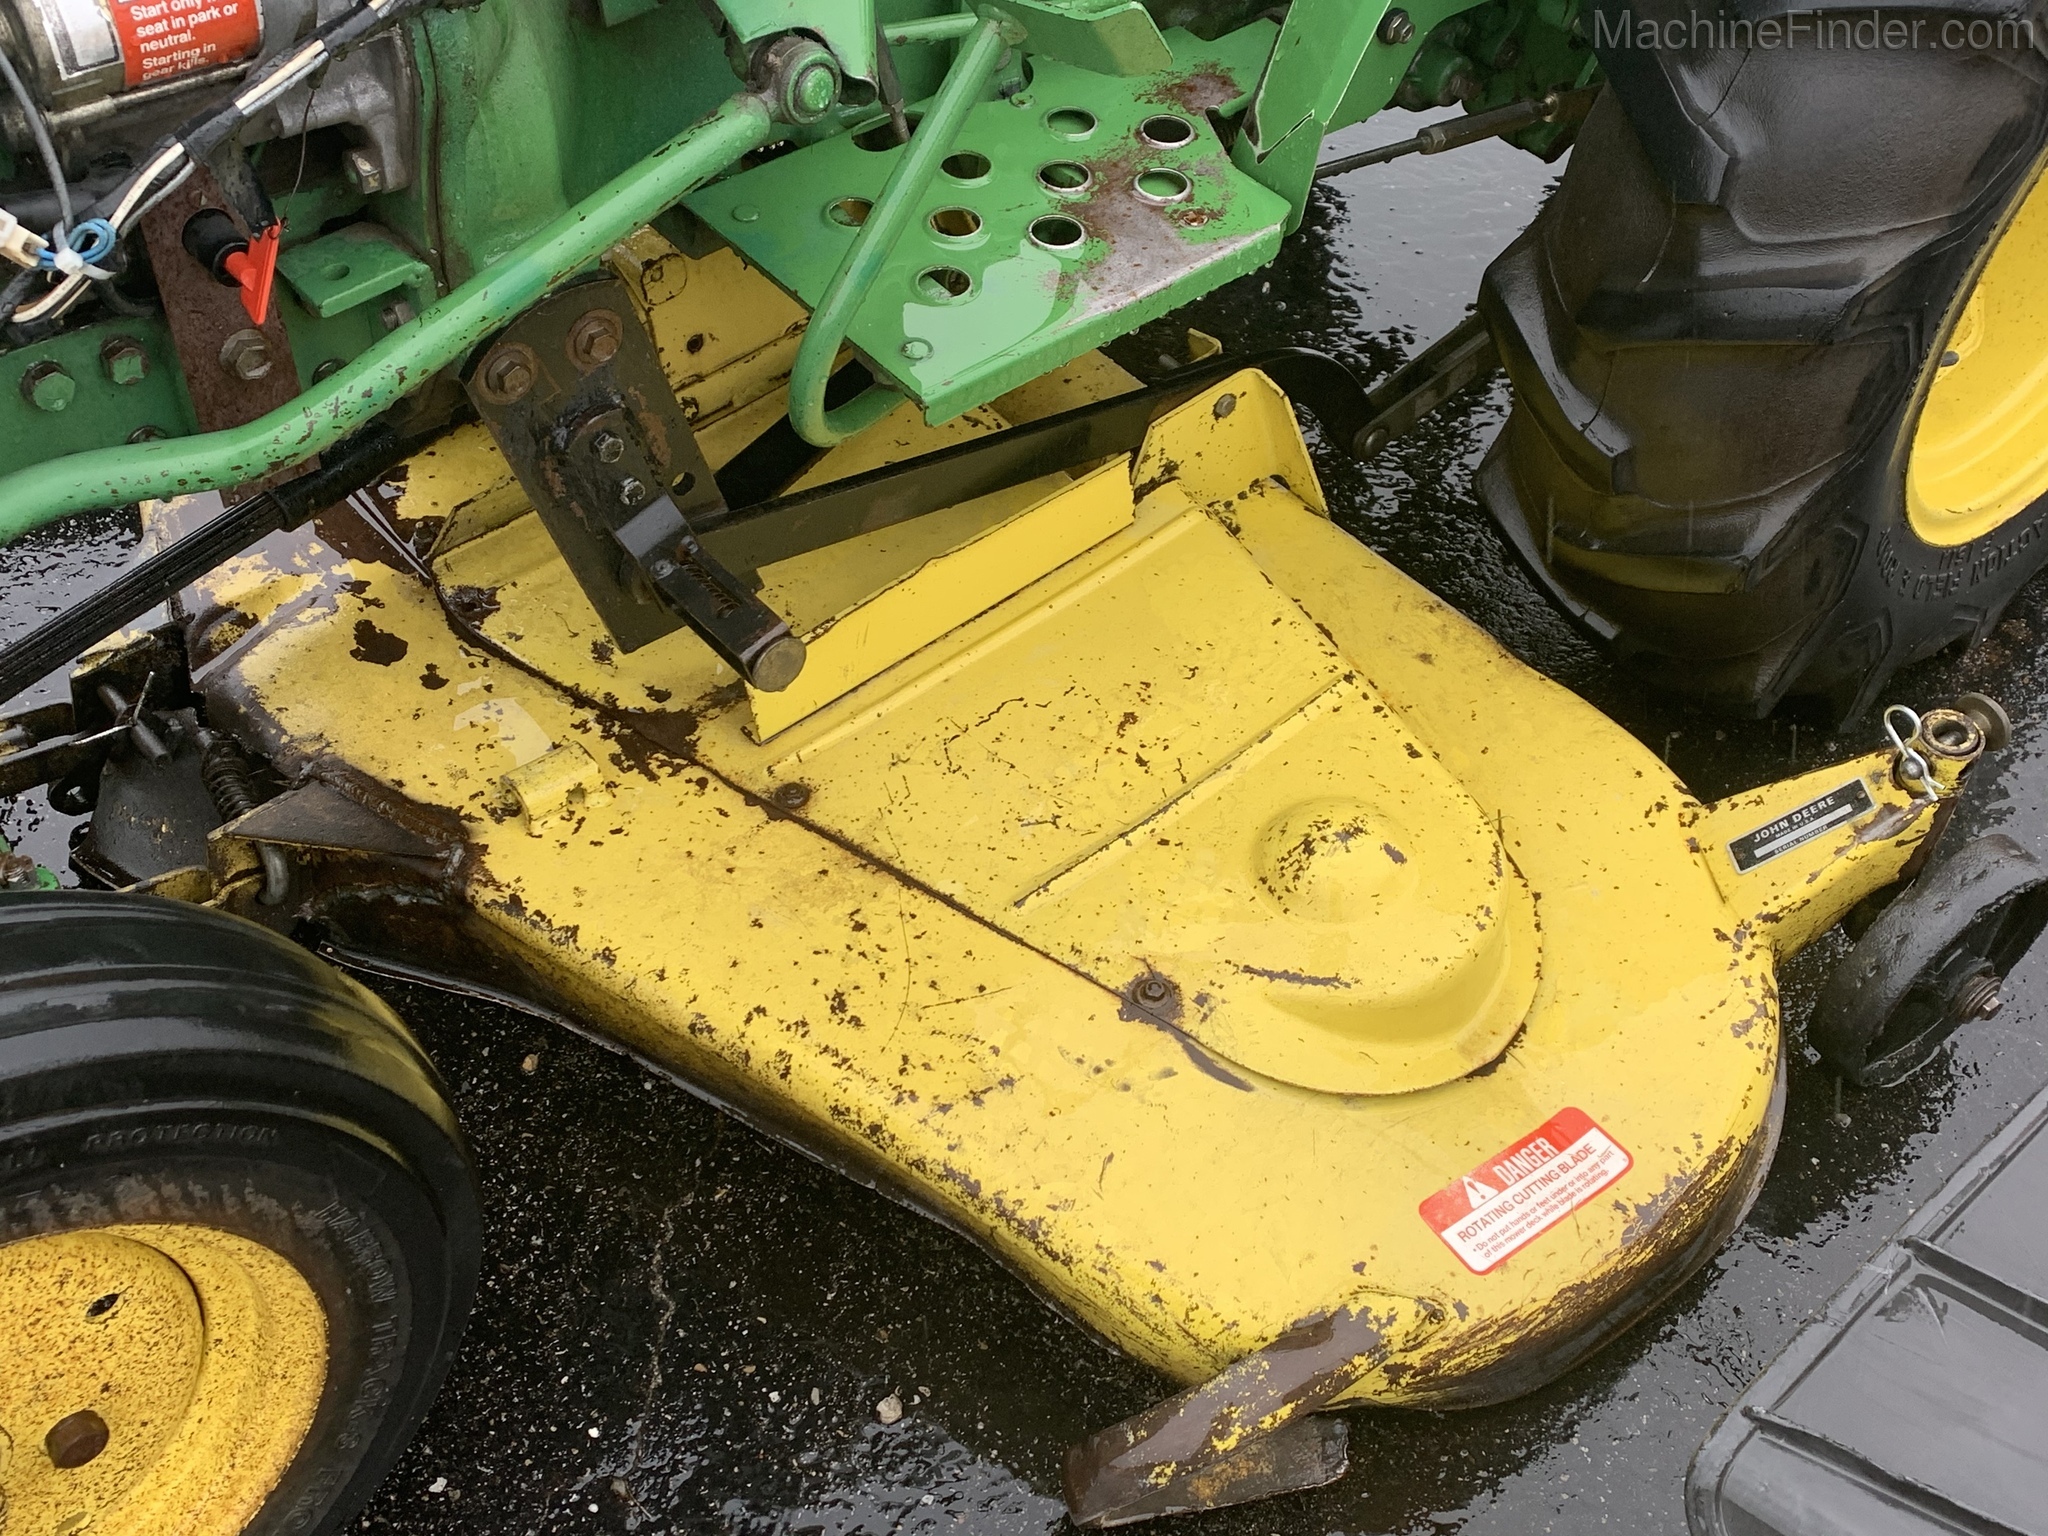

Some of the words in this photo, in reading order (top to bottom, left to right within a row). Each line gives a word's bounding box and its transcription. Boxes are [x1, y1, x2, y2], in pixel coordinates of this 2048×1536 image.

[130, 1, 169, 21] Start
[136, 18, 170, 38] seat
[170, 15, 186, 29] in
[187, 6, 221, 28] park
[223, 3, 238, 16] or
[140, 29, 196, 53] neutral.
[142, 48, 200, 69] Starting
[203, 43, 216, 53] in
[142, 64, 175, 80] gear
[1753, 819, 1789, 843] JOHN
[1791, 796, 1836, 823] DEERE
[1775, 827, 1791, 838] MADE
[1773, 840, 1797, 854] SERIAL
[1798, 824, 1828, 841] NUMBER
[84, 1122, 280, 1152] PROTECTION
[1492, 1137, 1559, 1187] DANGER
[1457, 1200, 1516, 1243] ROTATING
[1512, 1169, 1561, 1205] CUTTING
[1557, 1142, 1597, 1174] BLADE
[1475, 1241, 1489, 1251] Do
[1487, 1232, 1501, 1243] not
[1499, 1224, 1512, 1237] put
[1508, 1211, 1531, 1228] hands
[1529, 1206, 1538, 1214] or
[1536, 1196, 1552, 1209] feet
[1550, 1184, 1568, 1200] under
[1568, 1179, 1576, 1187] or
[1573, 1171, 1589, 1183] into
[1587, 1161, 1601, 1174] any
[1600, 1150, 1615, 1165] part
[1484, 1248, 1493, 1258] of
[1491, 1240, 1506, 1253] this
[1504, 1226, 1527, 1244] mower
[1526, 1215, 1543, 1229] deck
[1541, 1203, 1560, 1218] while
[1557, 1190, 1577, 1206] blade
[1575, 1186, 1584, 1194] is
[1581, 1168, 1609, 1190] rotating.
